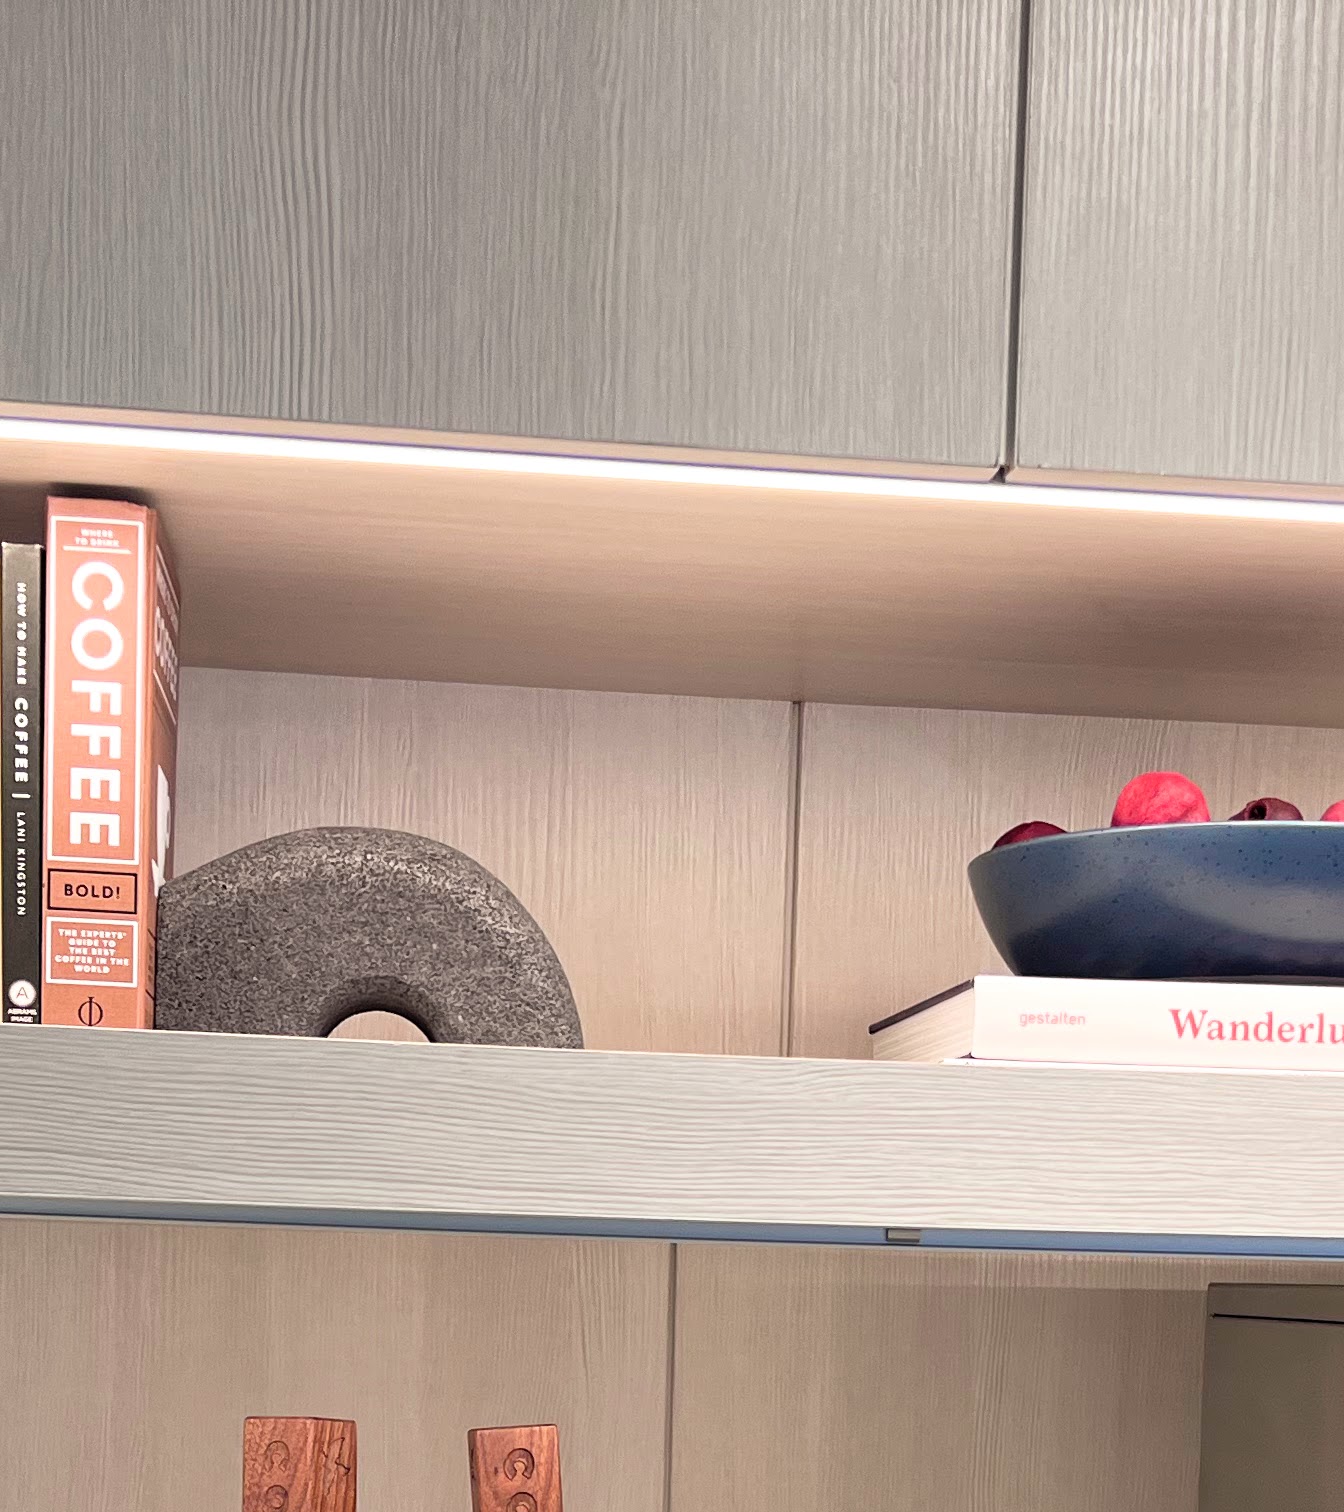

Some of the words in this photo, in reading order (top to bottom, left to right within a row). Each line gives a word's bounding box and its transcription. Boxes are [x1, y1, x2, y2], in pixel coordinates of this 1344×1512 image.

[16, 582, 28, 617] HOW
[16, 621, 28, 641] TO
[16, 645, 28, 685] MAKE
[69, 561, 125, 847] COFFEE
[14, 697, 30, 783] COFFEE
[16, 811, 27, 842] LANI
[16, 848, 28, 916] KINGSTON
[63, 883, 121, 900] BOLD!
[57, 928, 78, 938] THE
[68, 938, 100, 948] GUIDE
[102, 939, 117, 948] TO
[69, 946, 88, 955] THE
[91, 948, 116, 957] BEST
[54, 954, 93, 964] COFFEE
[96, 956, 108, 965] IN
[110, 957, 129, 967] THE
[73, 964, 111, 974] WORLD
[1019, 1010, 1086, 1027] gestalten
